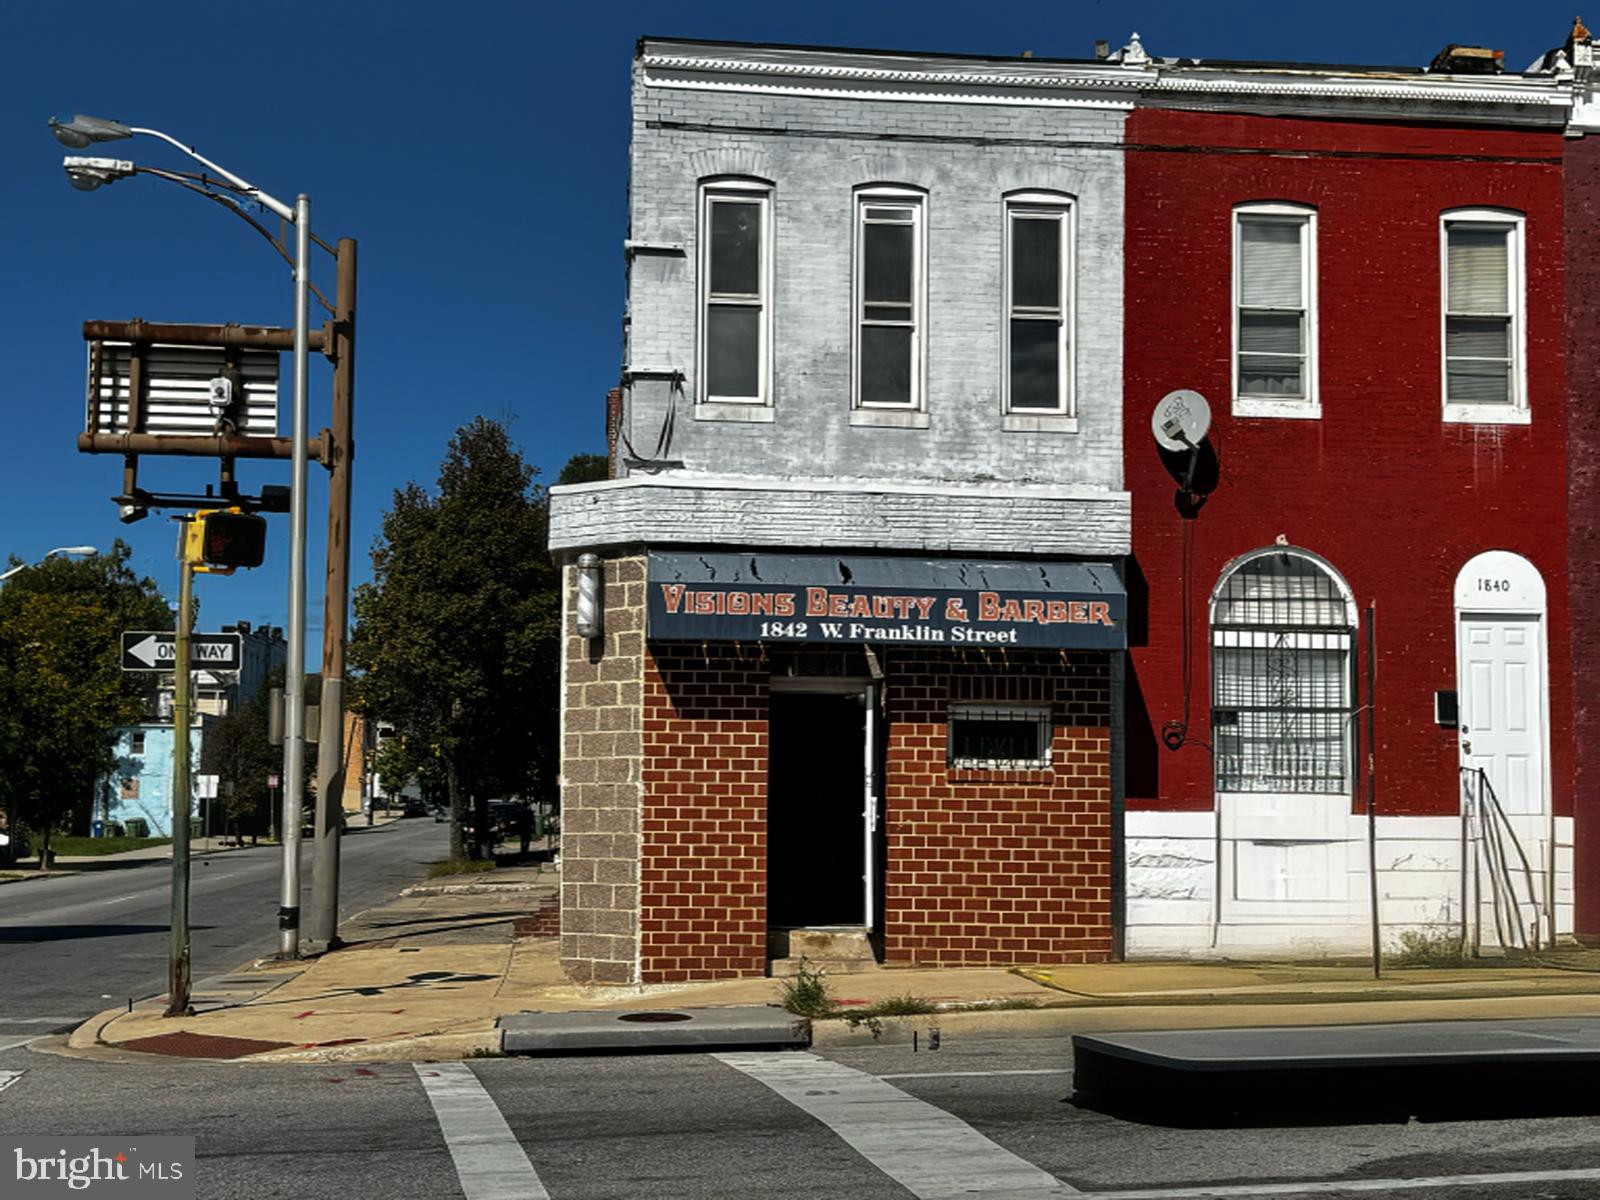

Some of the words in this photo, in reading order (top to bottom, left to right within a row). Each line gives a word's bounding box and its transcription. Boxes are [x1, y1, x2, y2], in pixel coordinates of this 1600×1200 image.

[1478, 578, 1511, 592] 1840
[661, 583, 796, 616] VISIONS
[805, 587, 936, 620] BEAUTY
[944, 597, 970, 623] &
[978, 591, 1115, 626] BARBER
[759, 622, 807, 637] 1842
[819, 622, 843, 638] W.
[849, 623, 944, 641] Franklin
[951, 625, 1018, 643] Street
[196, 645, 228, 659] WAY
